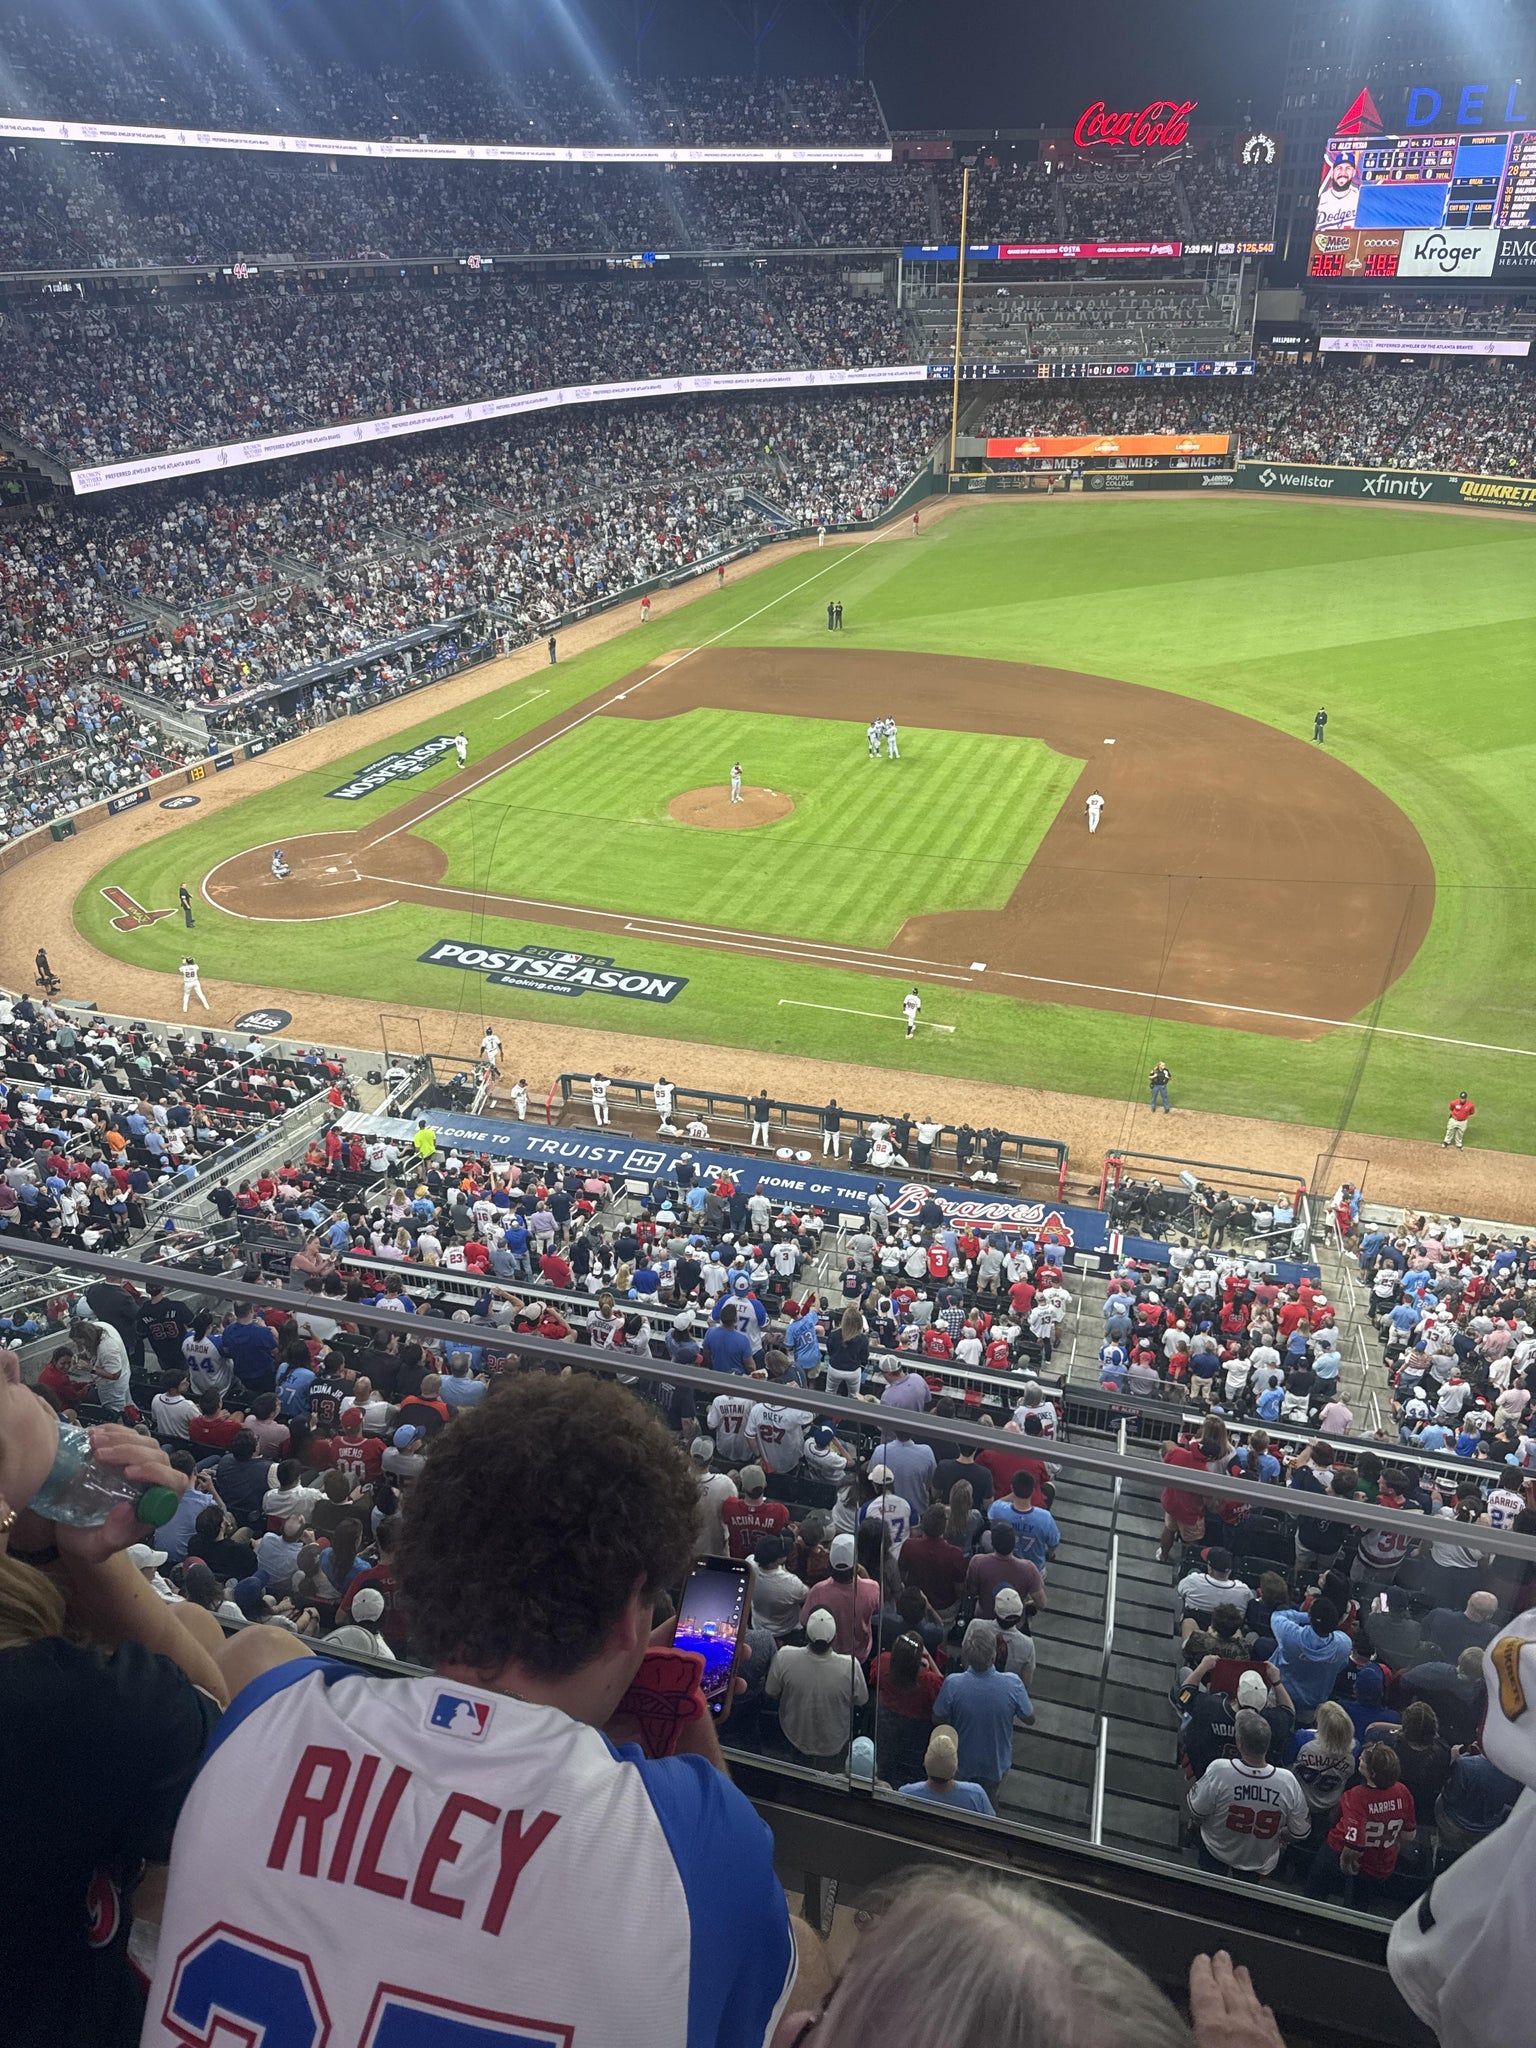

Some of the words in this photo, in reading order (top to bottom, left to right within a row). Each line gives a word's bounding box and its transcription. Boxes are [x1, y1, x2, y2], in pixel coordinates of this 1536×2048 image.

[1073, 101, 1198, 147] Coca-Cola
[1508, 166, 1519, 176] 28
[1184, 245, 1200, 253] 7:39
[1201, 245, 1213, 253] PM
[1414, 234, 1481, 272] Kroger
[1313, 255, 1343, 270] 364
[1366, 255, 1398, 270] 485
[233, 263, 248, 279] 44
[1225, 366, 1237, 375] 70
[105, 471, 131, 480] PREFERRED
[131, 467, 151, 476] JEWELER
[166, 461, 185, 469] ATLANTA
[185, 458, 201, 466] BRAVES
[1054, 458, 1085, 470] MLB+
[1129, 457, 1160, 469] MLB+
[1279, 473, 1334, 488] Wellstar
[1362, 473, 1433, 499] xfinity
[1460, 481, 1536, 501] QUIKRETE
[251, 743, 264, 754] FOX
[190, 766, 205, 781] 133
[333, 737, 456, 798] POSTSEASON
[125, 792, 138, 804] SHOP
[525, 947, 549, 956] 20
[430, 943, 677, 998] POSTSEASON
[500, 975, 572, 993] Booking.com
[245, 1014, 282, 1028] NLDS
[492, 1134, 511, 1144] TO
[525, 1137, 624, 1164] TRUIST
[758, 1175, 805, 1191] HOME
[809, 1182, 834, 1194] OF
[837, 1186, 868, 1201] THE
[449, 1253, 463, 1264] 23
[782, 1252, 788, 1261] 3
[935, 1256, 943, 1266] 3
[1041, 1316, 1051, 1325] 13
[151, 1322, 179, 1340] 23
[800, 1332, 813, 1345] 13
[1427, 1331, 1440, 1342] 13
[186, 1343, 209, 1354] AARON
[186, 1355, 214, 1373] 44
[310, 1381, 331, 1396] ACUÑA
[311, 1399, 335, 1424] 13
[720, 1404, 745, 1415] OHTANI
[762, 1411, 784, 1423] RILEY
[1409, 1408, 1426, 1417] 44
[723, 1416, 743, 1434] 17
[759, 1424, 787, 1445] 27
[1489, 1497, 1518, 1510] HARRIS
[731, 1514, 760, 1528] ACUÑA
[1234, 1785, 1281, 1807] SMOLTZ
[1368, 1799, 1396, 1815] HARRIS
[1397, 1798, 1403, 1811] II
[1225, 1804, 1281, 1840] 29
[1364, 1818, 1404, 1849] 23
[265, 1744, 563, 1939] RILEY
